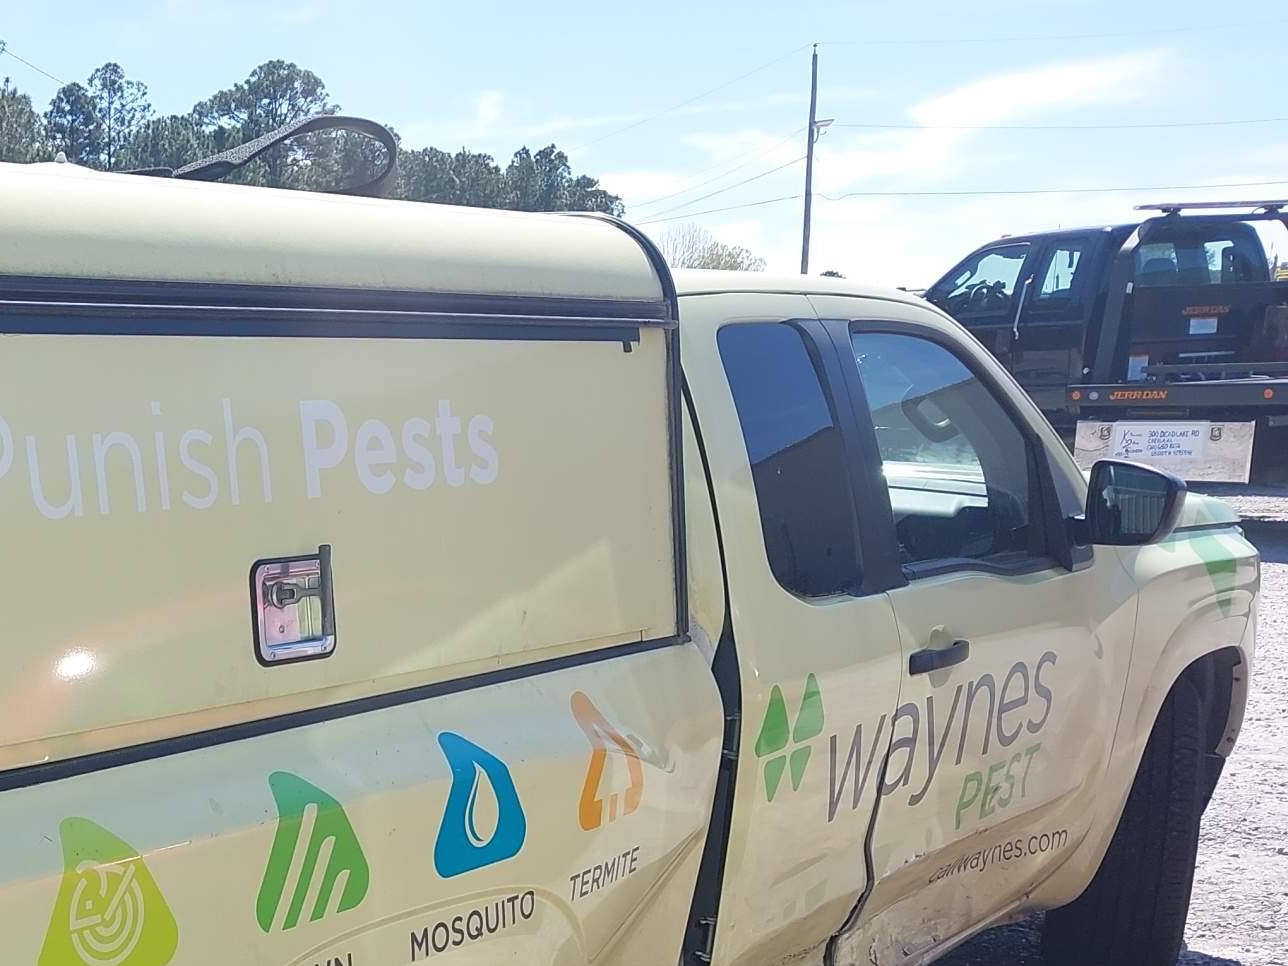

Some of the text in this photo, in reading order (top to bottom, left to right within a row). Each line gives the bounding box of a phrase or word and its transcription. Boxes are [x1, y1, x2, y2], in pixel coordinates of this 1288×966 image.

[300, 398, 500, 499] Pests
[826, 650, 1057, 823] waynes
[953, 742, 1042, 831] PEST
[569, 846, 641, 903] TERMITE
[408, 888, 536, 963] MOSQUITO
